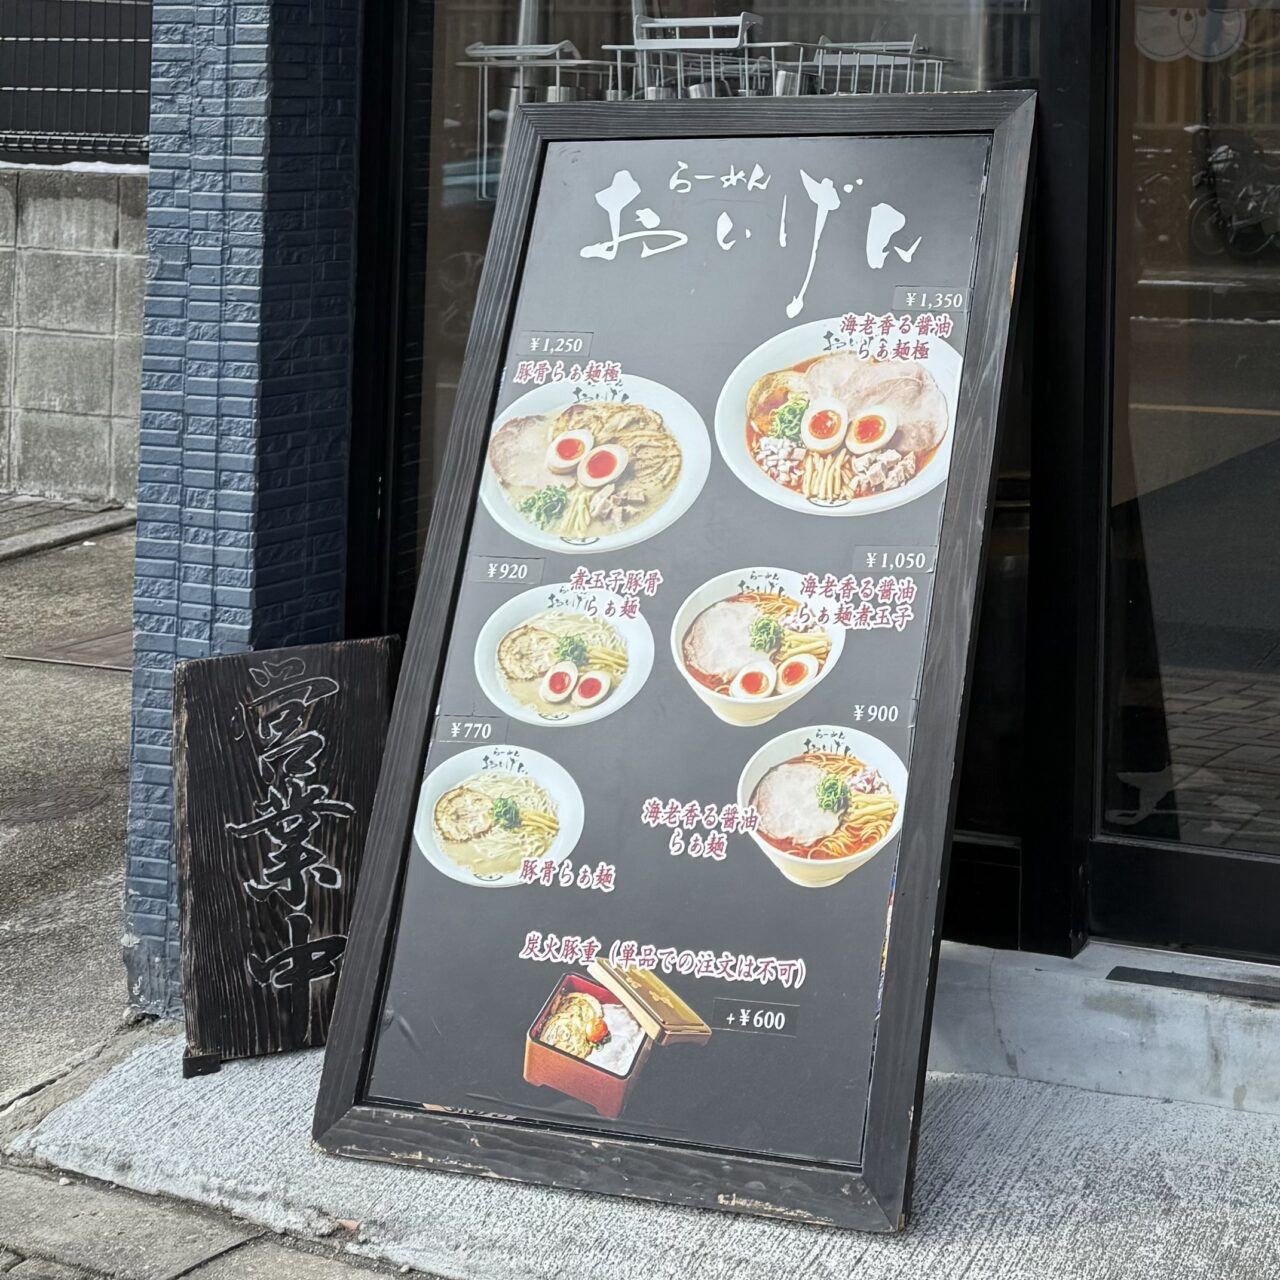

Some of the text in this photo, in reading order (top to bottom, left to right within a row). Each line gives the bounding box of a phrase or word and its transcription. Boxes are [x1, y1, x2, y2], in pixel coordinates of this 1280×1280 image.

[668, 161, 772, 194] らーめん
[579, 169, 923, 319] おいげん
[906, 292, 963, 309] ¥1,350
[840, 312, 954, 339] 海老香る醤油
[530, 337, 583, 353] ¥1,250
[487, 563, 528, 579] ¥920
[866, 552, 926, 570] ¥1,050
[570, 566, 663, 596] 煮玉子豚骨
[799, 573, 918, 604] 海老香る醤油
[853, 704, 899, 722] ¥900
[451, 722, 492, 739] ¥770
[642, 797, 761, 834] 海老香る醤油
[226, 656, 358, 1045] 営業中
